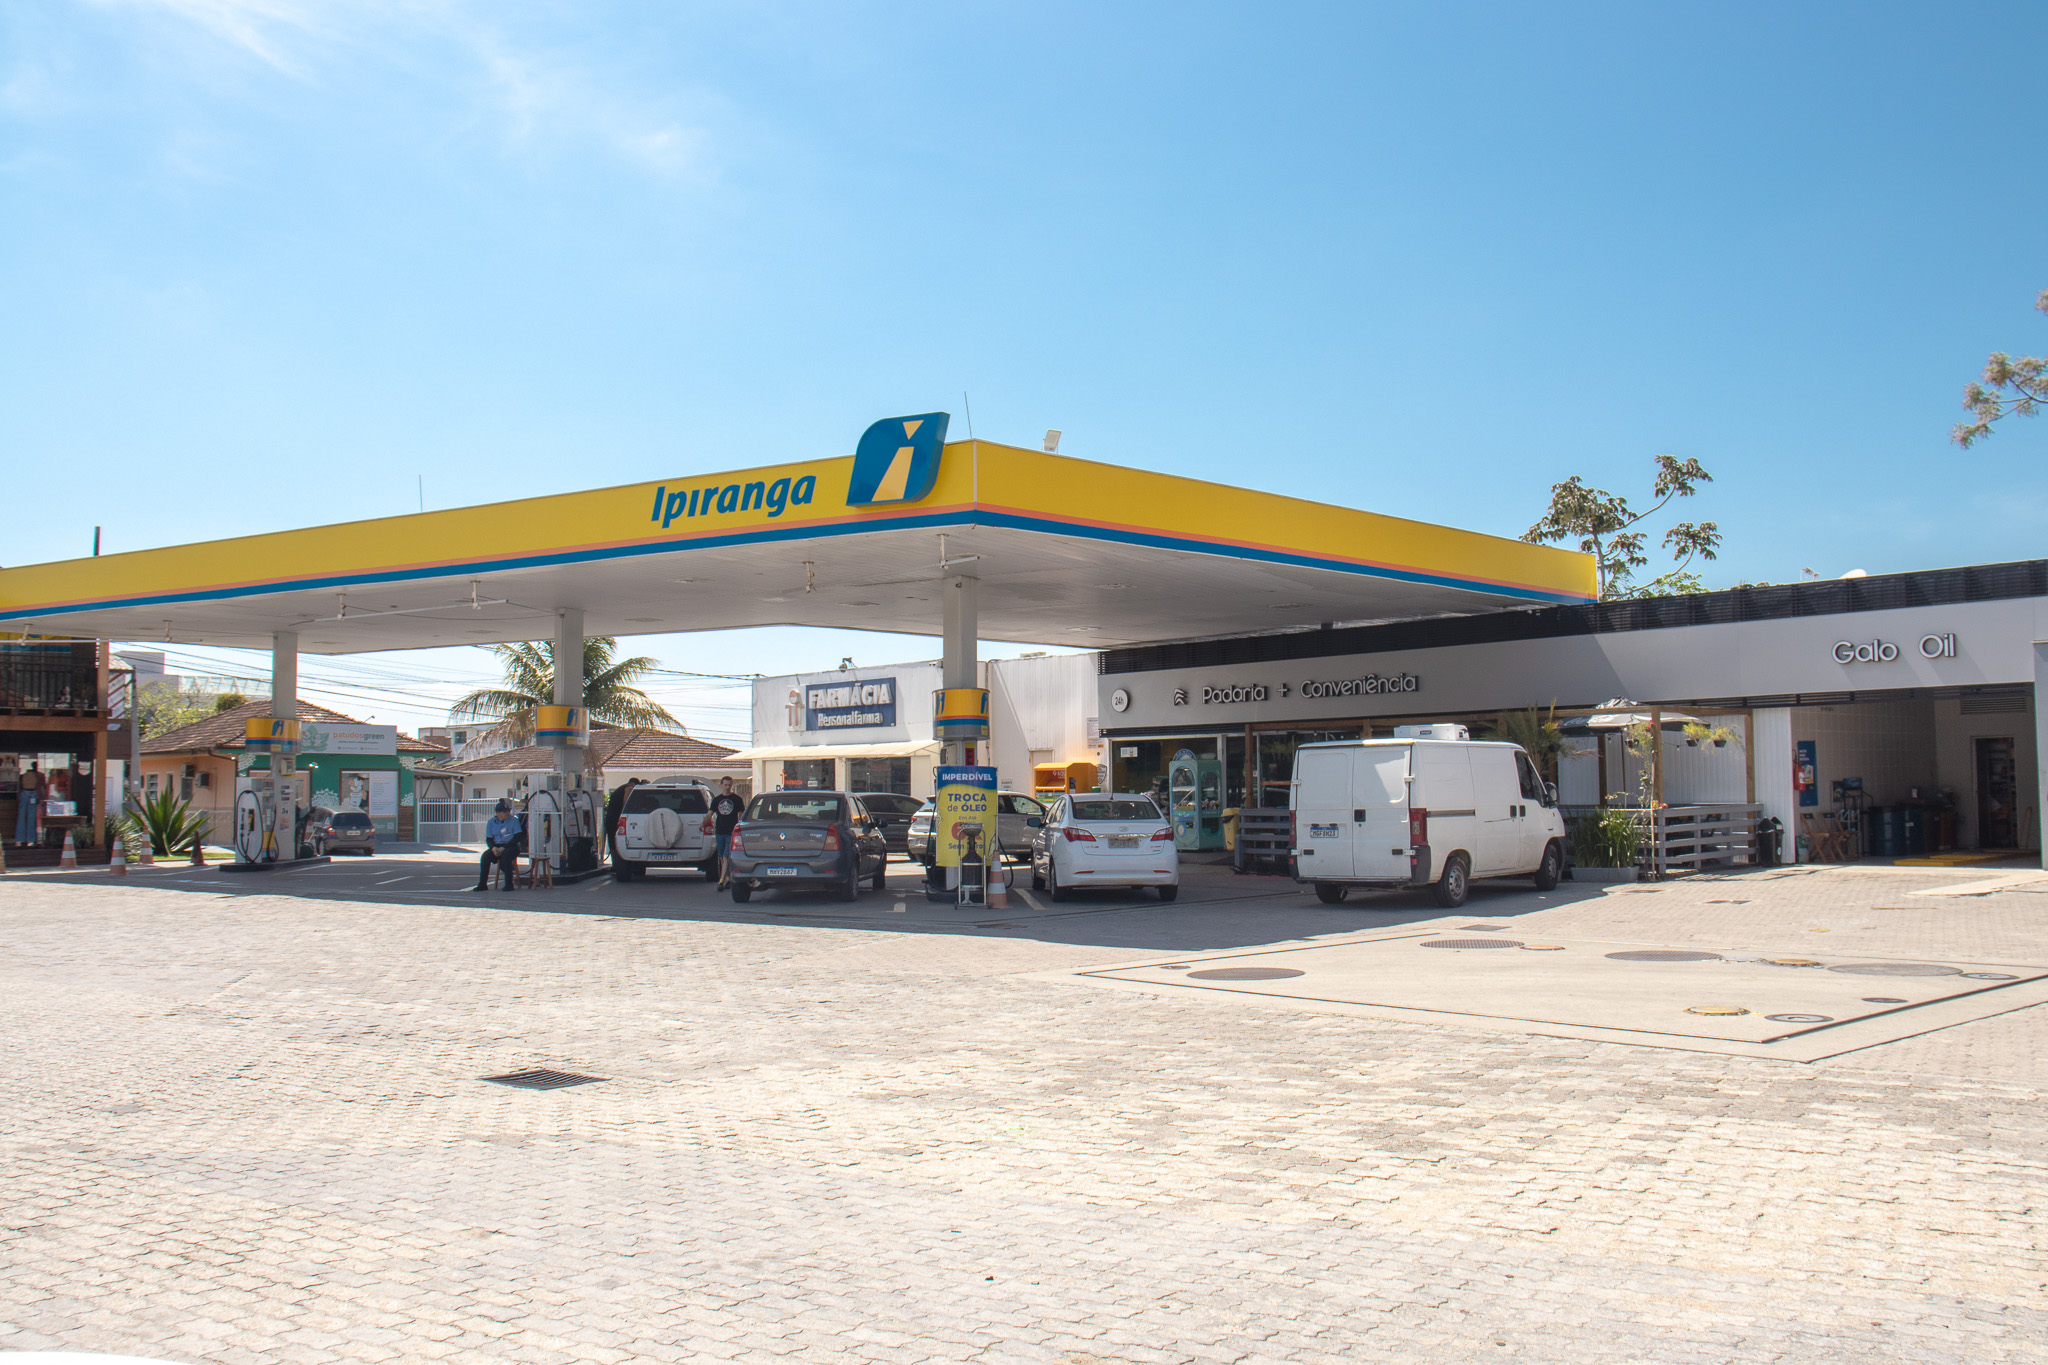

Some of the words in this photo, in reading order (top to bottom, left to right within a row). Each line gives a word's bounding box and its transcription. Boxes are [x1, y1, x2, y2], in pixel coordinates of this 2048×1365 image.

[651, 475, 816, 529] Ipiranga
[1831, 639, 1898, 664] Galo
[1919, 632, 1956, 658] Oil
[808, 683, 891, 709] FARMÁCIA
[1202, 684, 1266, 704] Padaria
[1300, 672, 1417, 698] Conveniência
[1114, 695, 1125, 706] 24h
[942, 771, 993, 781] IMPERDÍVEL
[947, 793, 987, 802] TROCA
[947, 803, 958, 812] de
[961, 801, 987, 812] ÓLEO
